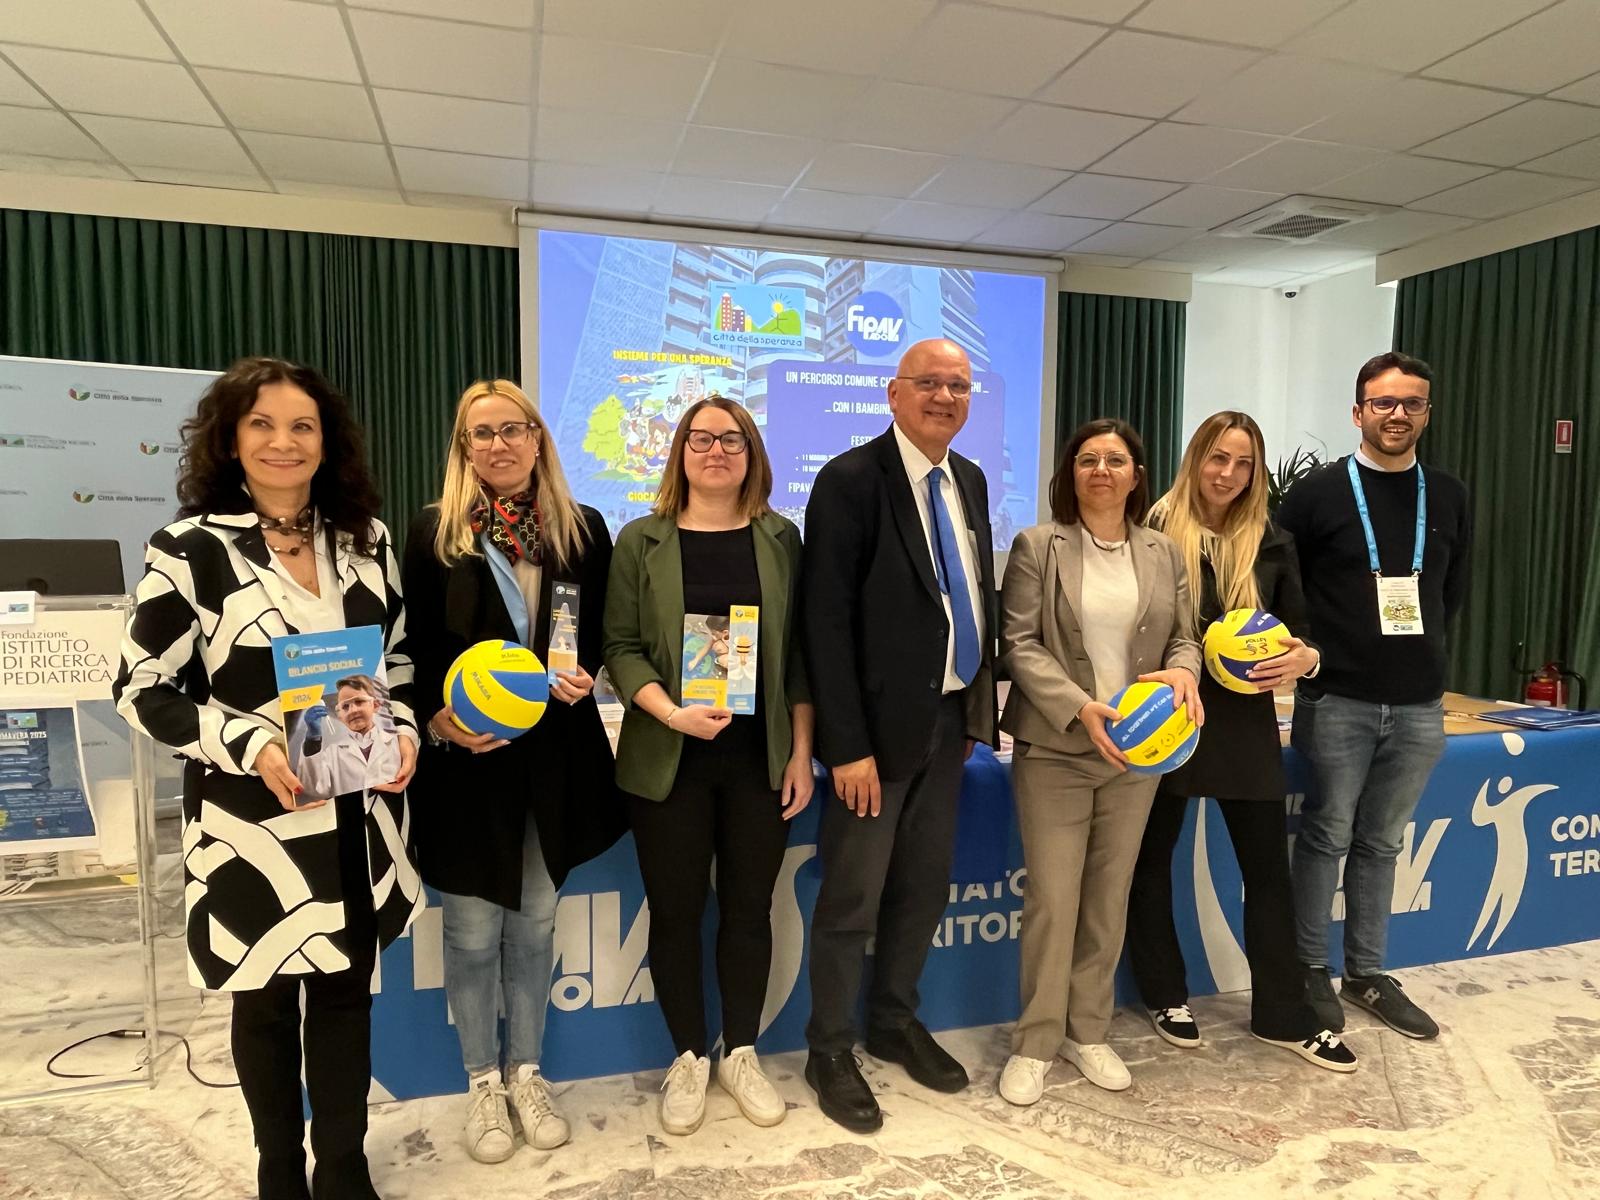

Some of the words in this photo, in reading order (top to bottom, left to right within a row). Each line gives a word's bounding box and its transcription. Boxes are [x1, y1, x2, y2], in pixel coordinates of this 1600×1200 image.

[613, 350, 649, 361] INSIEME
[651, 352, 667, 362] PER
[670, 353, 687, 364] UNA
[689, 354, 733, 367] SPERANZA
[786, 371, 798, 383] UN
[800, 372, 843, 386] PERCORSO
[845, 374, 879, 388] COMUNE
[833, 402, 849, 413] CON
[1, 629, 68, 640] Fondazione
[3, 639, 89, 655] ISTITUTO
[3, 655, 23, 670] DI
[31, 653, 109, 669] RICERCA
[4, 669, 113, 685] PEDIATRICA
